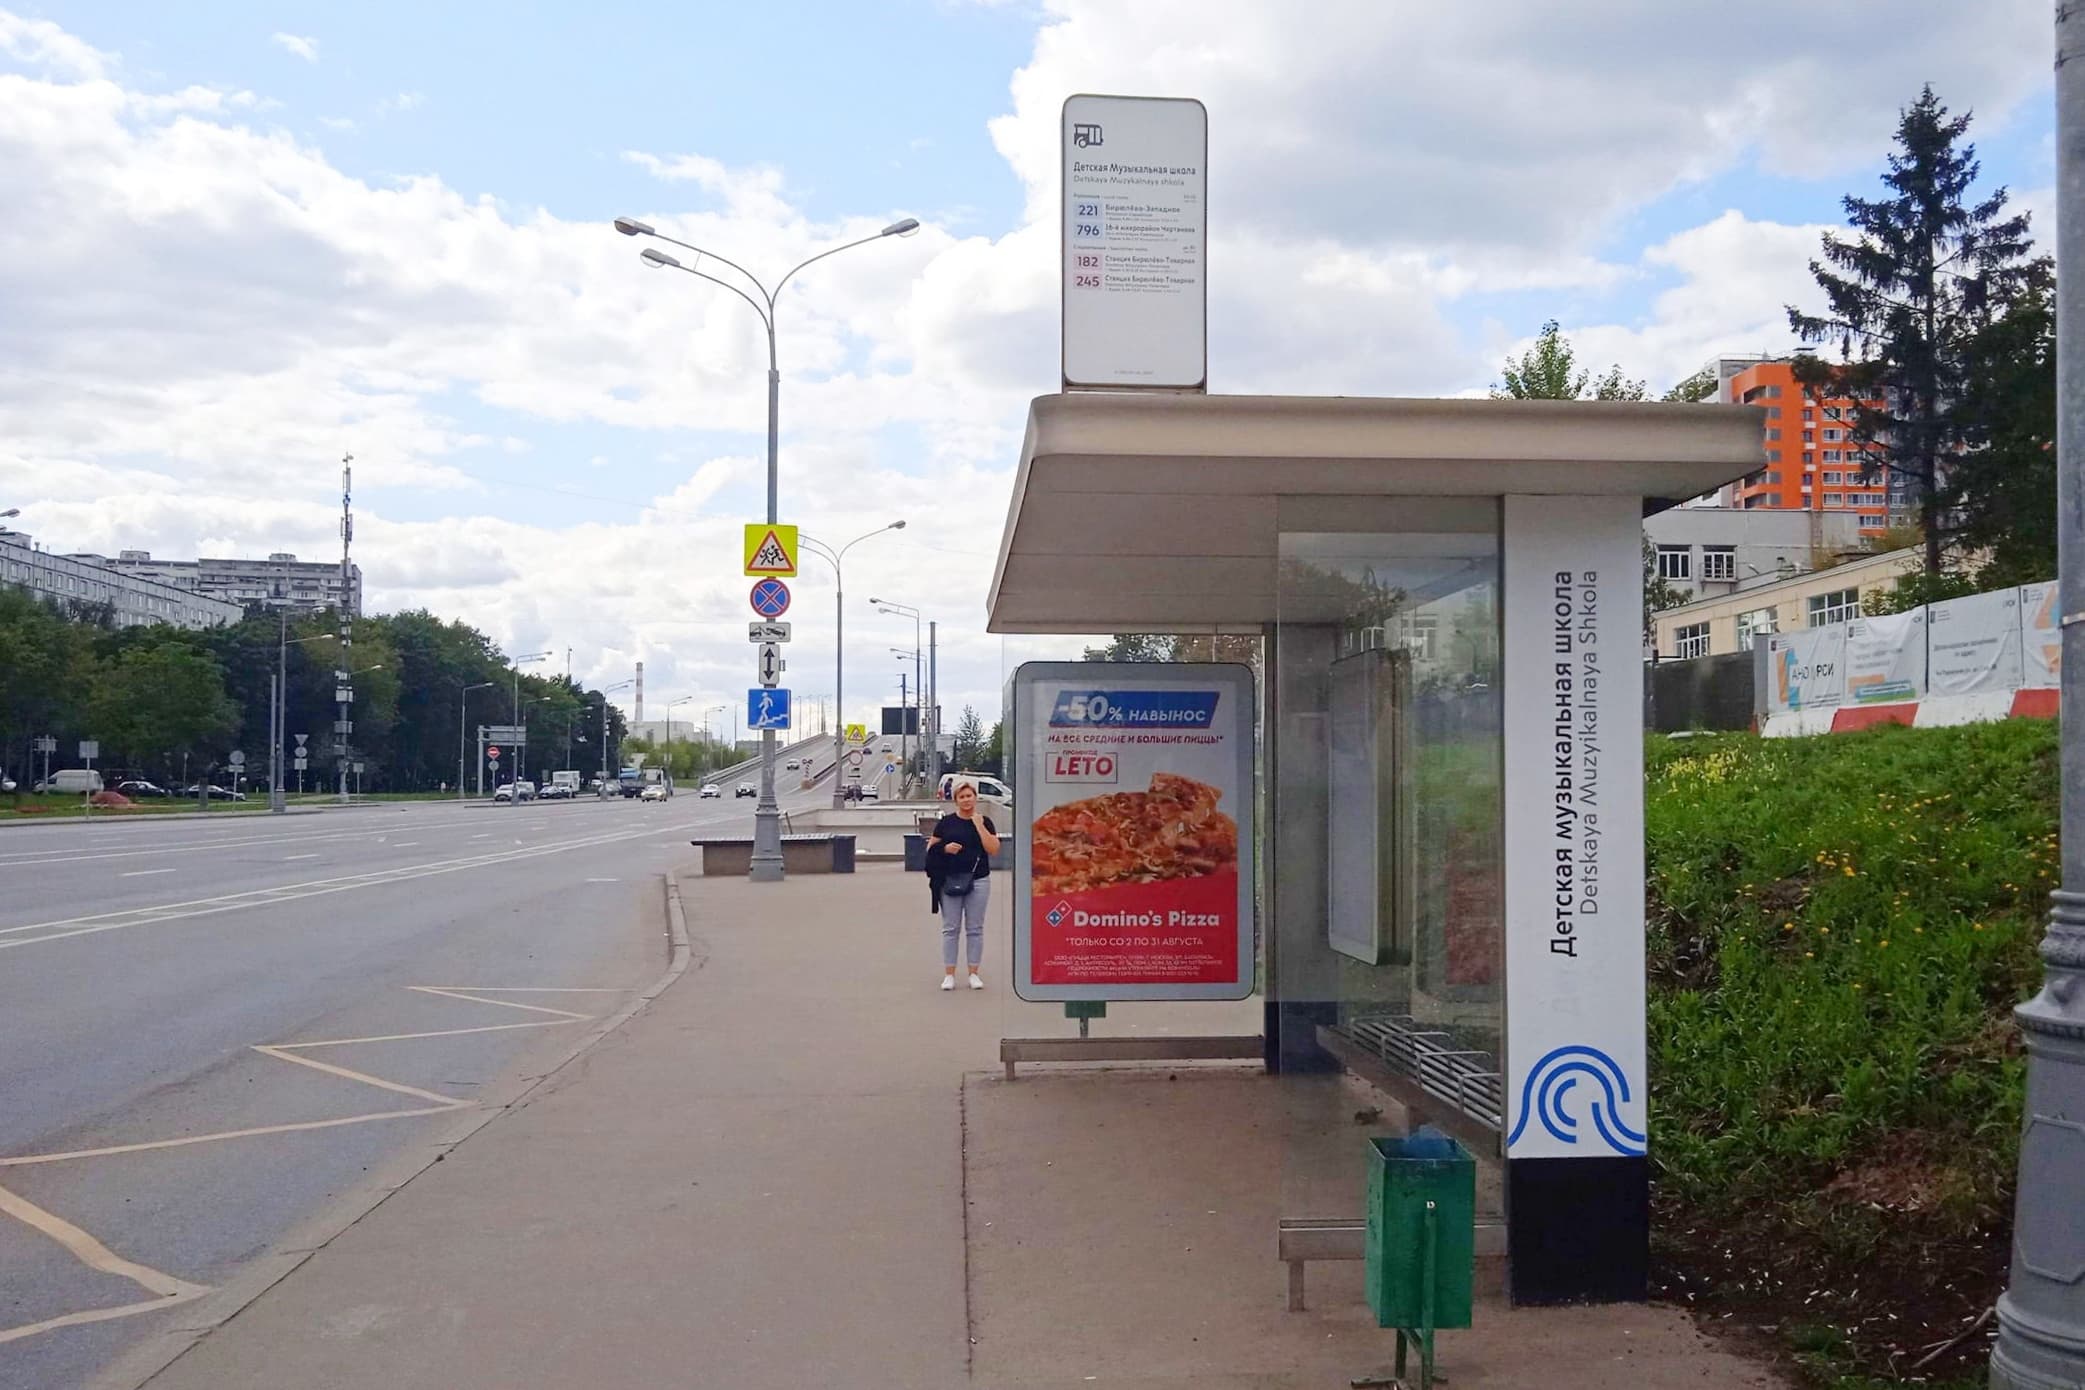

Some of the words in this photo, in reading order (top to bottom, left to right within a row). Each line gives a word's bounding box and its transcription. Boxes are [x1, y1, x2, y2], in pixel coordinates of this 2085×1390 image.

[1073, 161, 1108, 173] Детская
[1109, 163, 1168, 175] Музыкальная
[1169, 166, 1196, 175] школа
[1078, 205, 1098, 217] 221
[1076, 224, 1100, 236] 796
[1077, 256, 1099, 268] 182
[1076, 276, 1100, 287] 245
[1555, 570, 1572, 653] школа
[1577, 570, 1597, 645] Shkola
[1578, 652, 1601, 806] Muzyikalnaya
[1048, 735, 1060, 743] НА
[1063, 735, 1081, 743] ВСЕ
[1083, 735, 1126, 744] СРЕДНИЕ
[1128, 735, 1135, 744] И
[1136, 735, 1183, 744] БОЛЬШИЕ
[1555, 662, 1578, 840] музыкальная
[1055, 756, 1113, 776] LETO
[1578, 813, 1602, 914] Detskaya
[1550, 848, 1577, 957] Детская
[1073, 909, 1163, 927] Domino's
[1168, 910, 1220, 927] Pizza
[1109, 937, 1125, 946] СО
[1126, 937, 1132, 946] 2
[1134, 937, 1150, 946] ПО
[1151, 937, 1160, 946] 31
[1162, 937, 1204, 946] АВГУСТА
